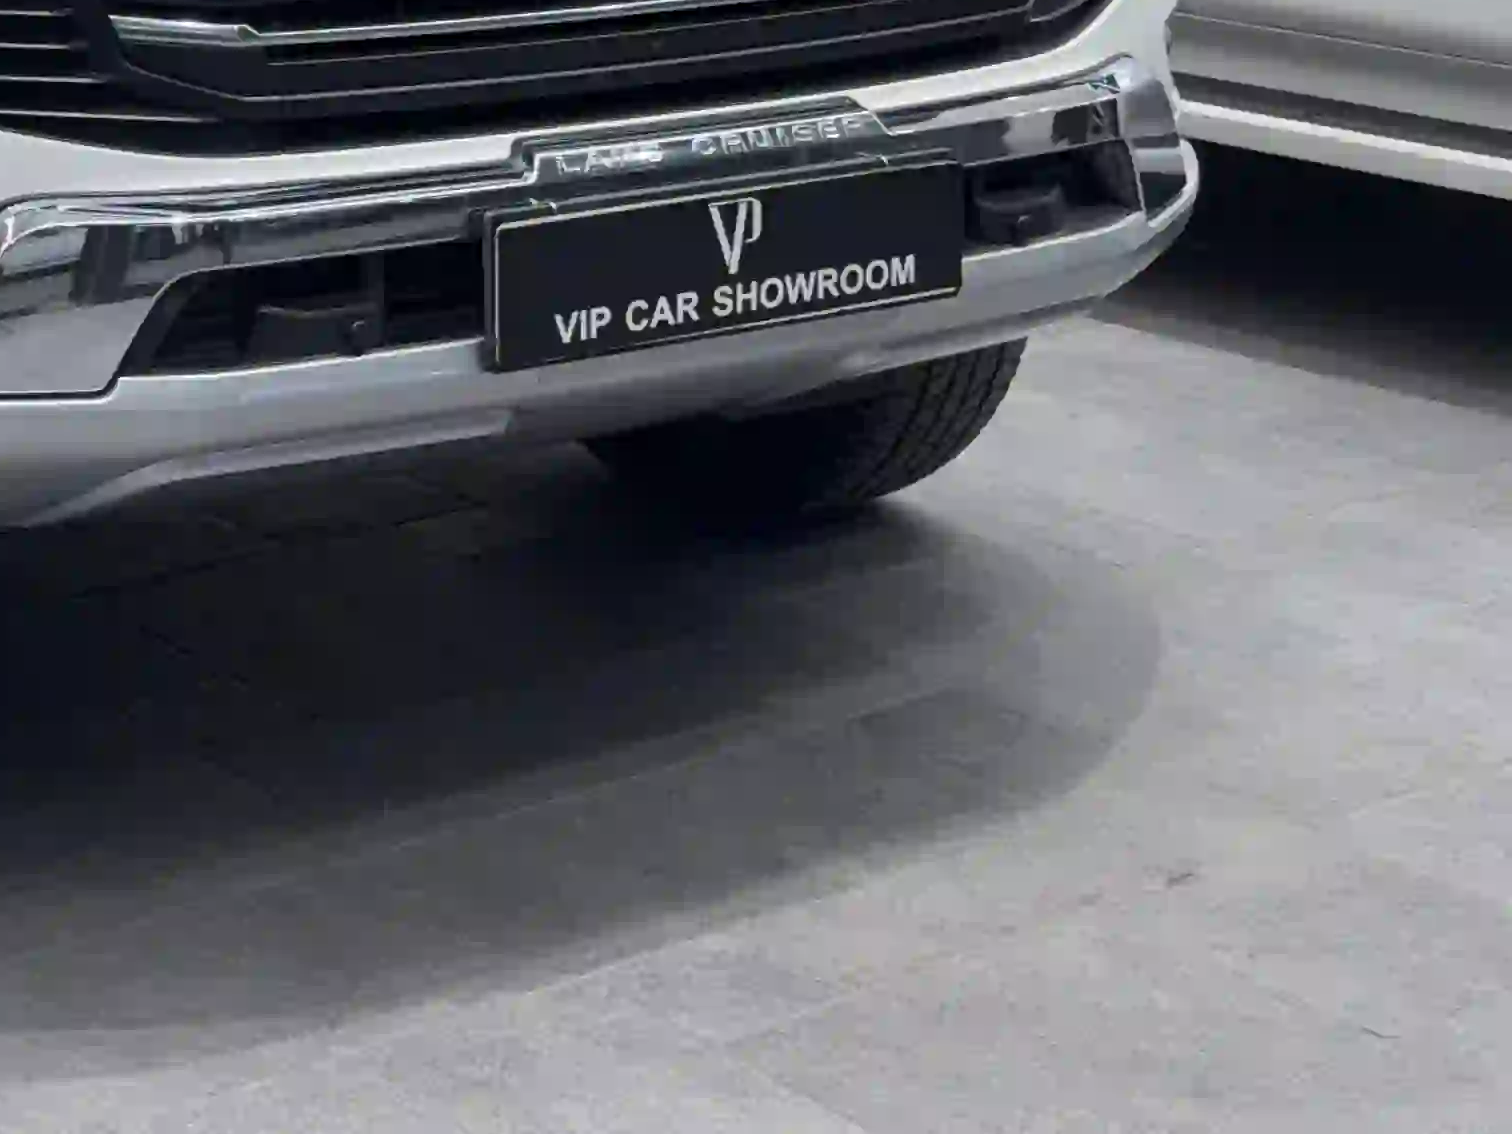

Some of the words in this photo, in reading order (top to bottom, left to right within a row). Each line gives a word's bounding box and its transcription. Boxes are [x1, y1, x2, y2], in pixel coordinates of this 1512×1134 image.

[554, 306, 612, 344] VIP
[625, 291, 700, 332] CAR
[712, 254, 916, 318] SHOWROOM
